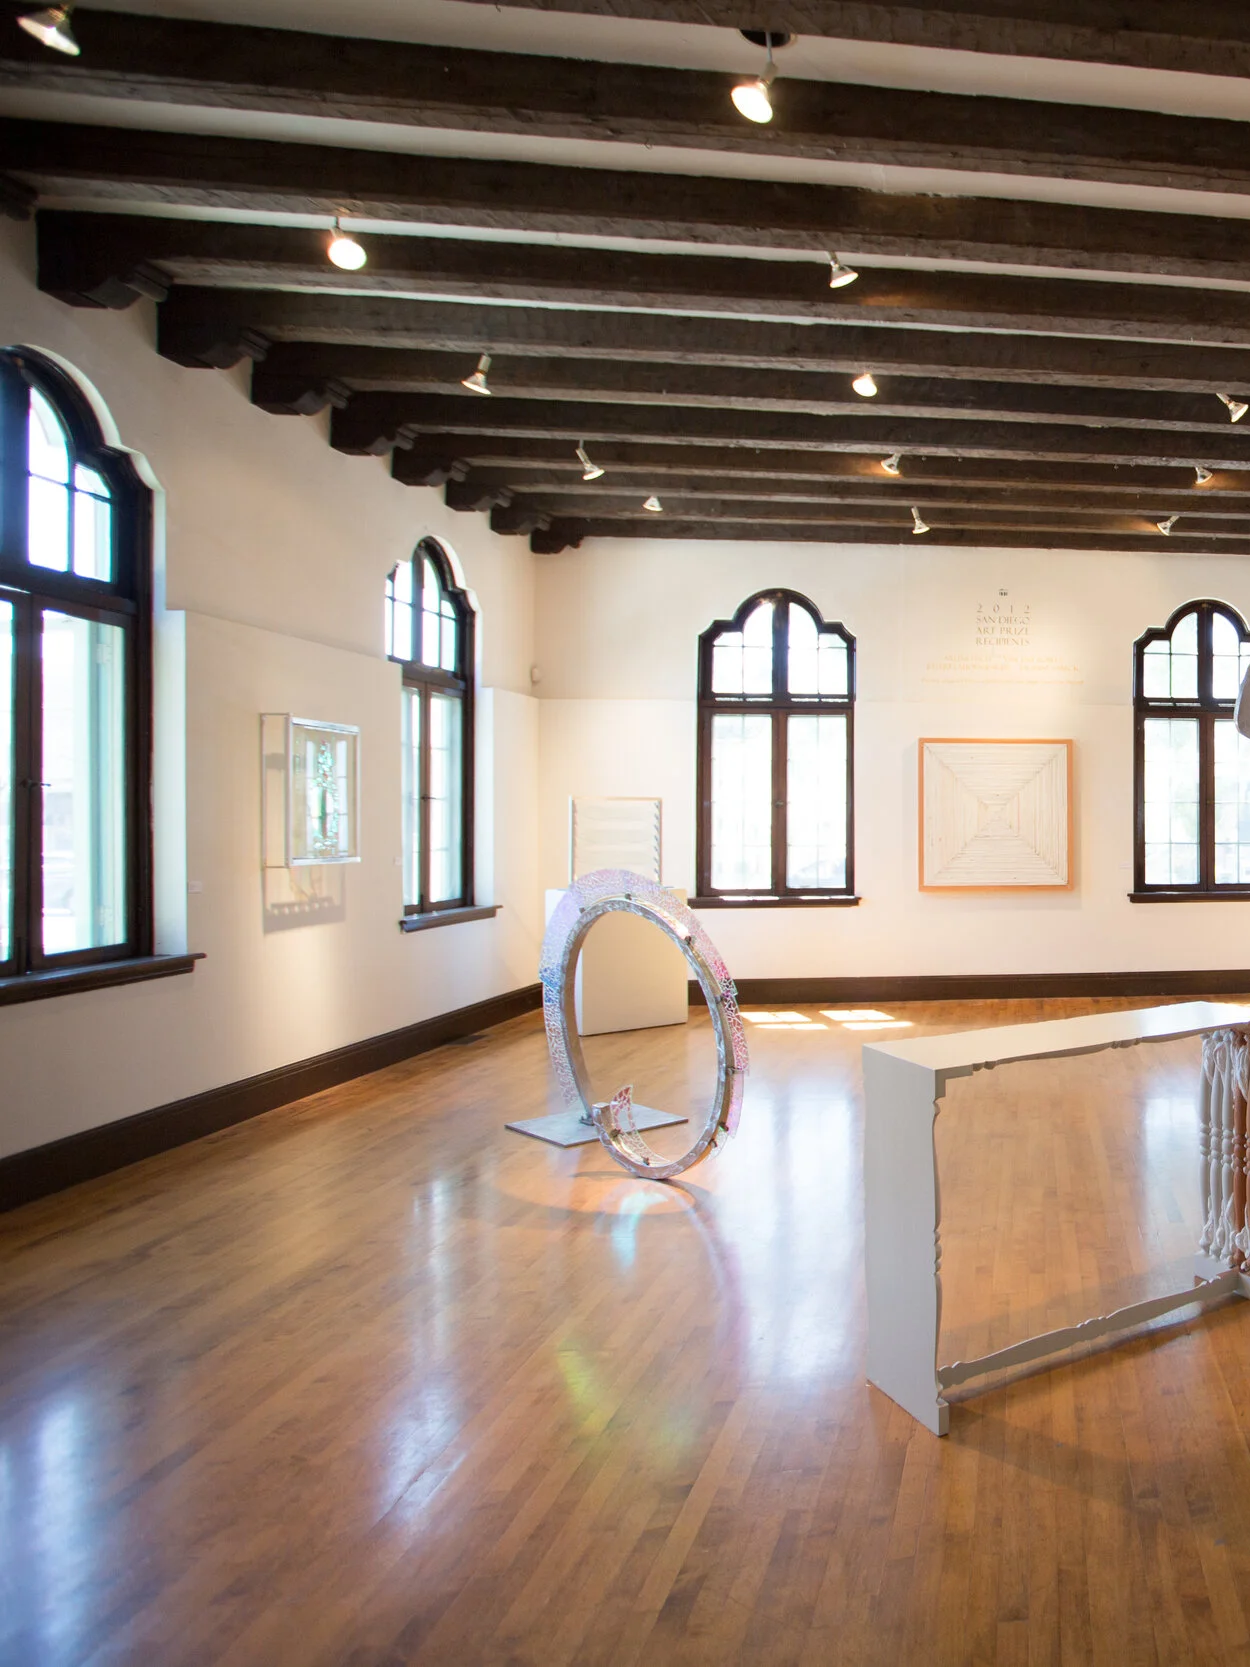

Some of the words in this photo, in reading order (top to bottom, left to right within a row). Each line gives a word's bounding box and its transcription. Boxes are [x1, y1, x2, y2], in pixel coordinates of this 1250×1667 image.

[975, 615, 996, 624] SAN
[998, 615, 1031, 625] DIEGO
[976, 626, 995, 635] ART
[999, 627, 1029, 636] PRIZE
